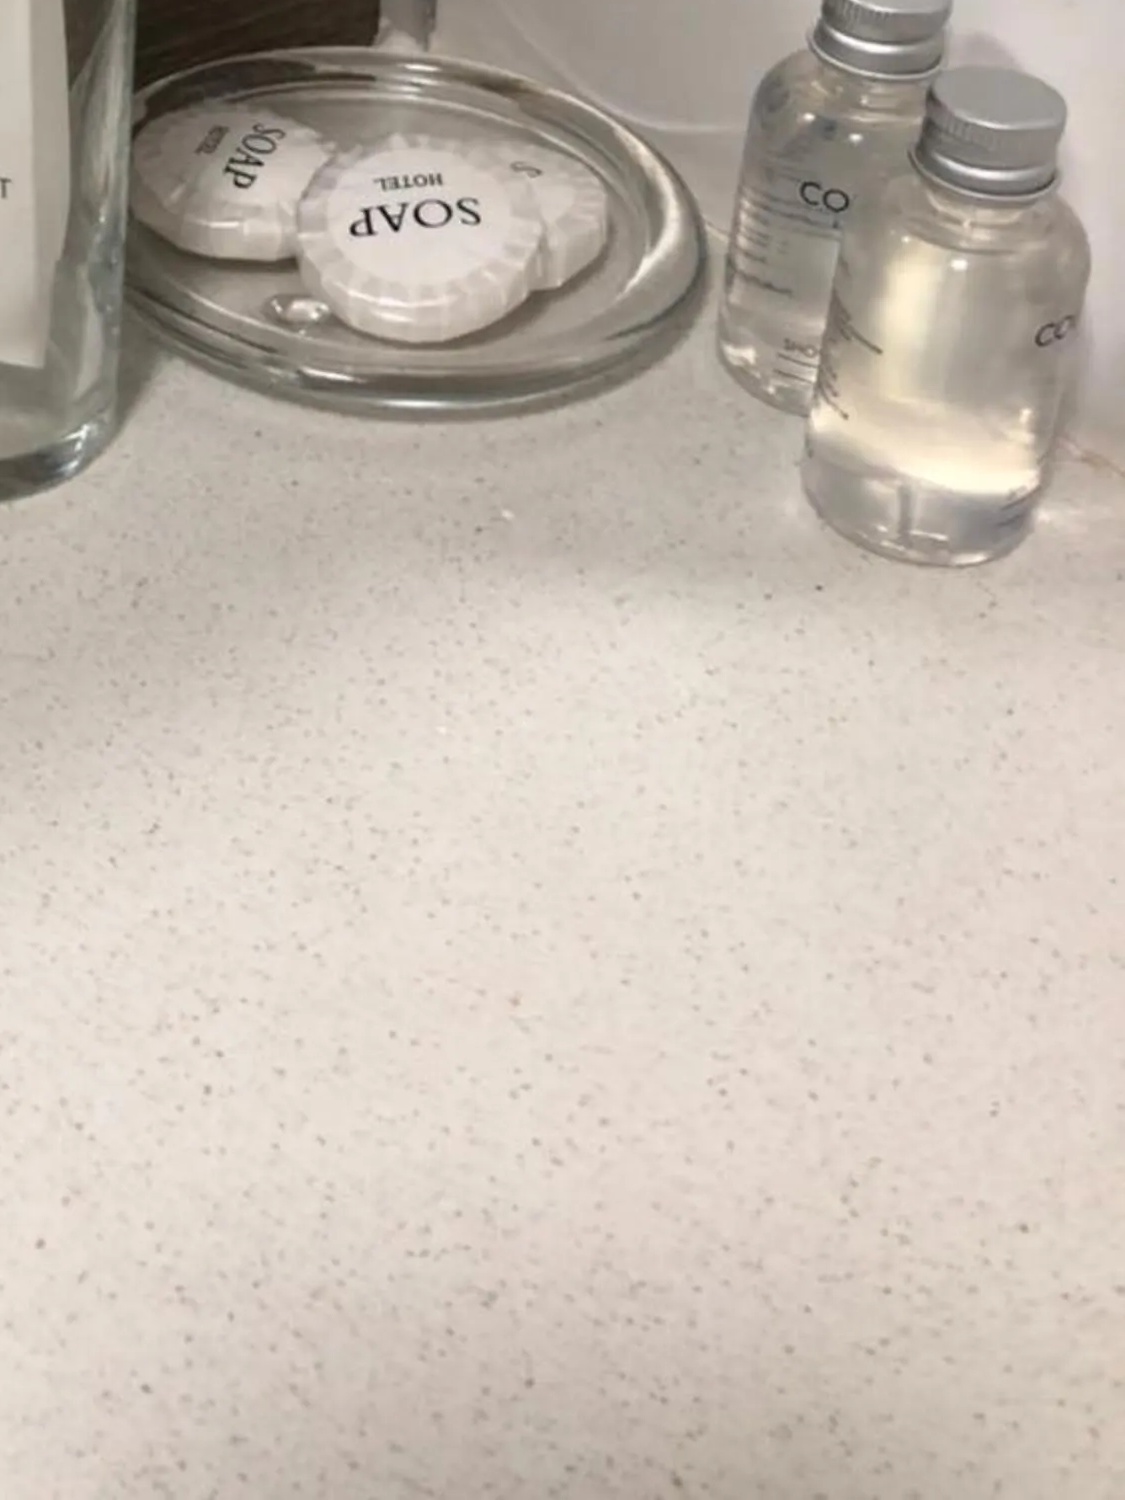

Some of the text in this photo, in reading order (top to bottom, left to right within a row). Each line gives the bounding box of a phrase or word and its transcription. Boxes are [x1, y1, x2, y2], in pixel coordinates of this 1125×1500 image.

[223, 122, 287, 189] SOAP
[374, 172, 444, 192] HOTEL
[348, 196, 482, 238] SOAP
